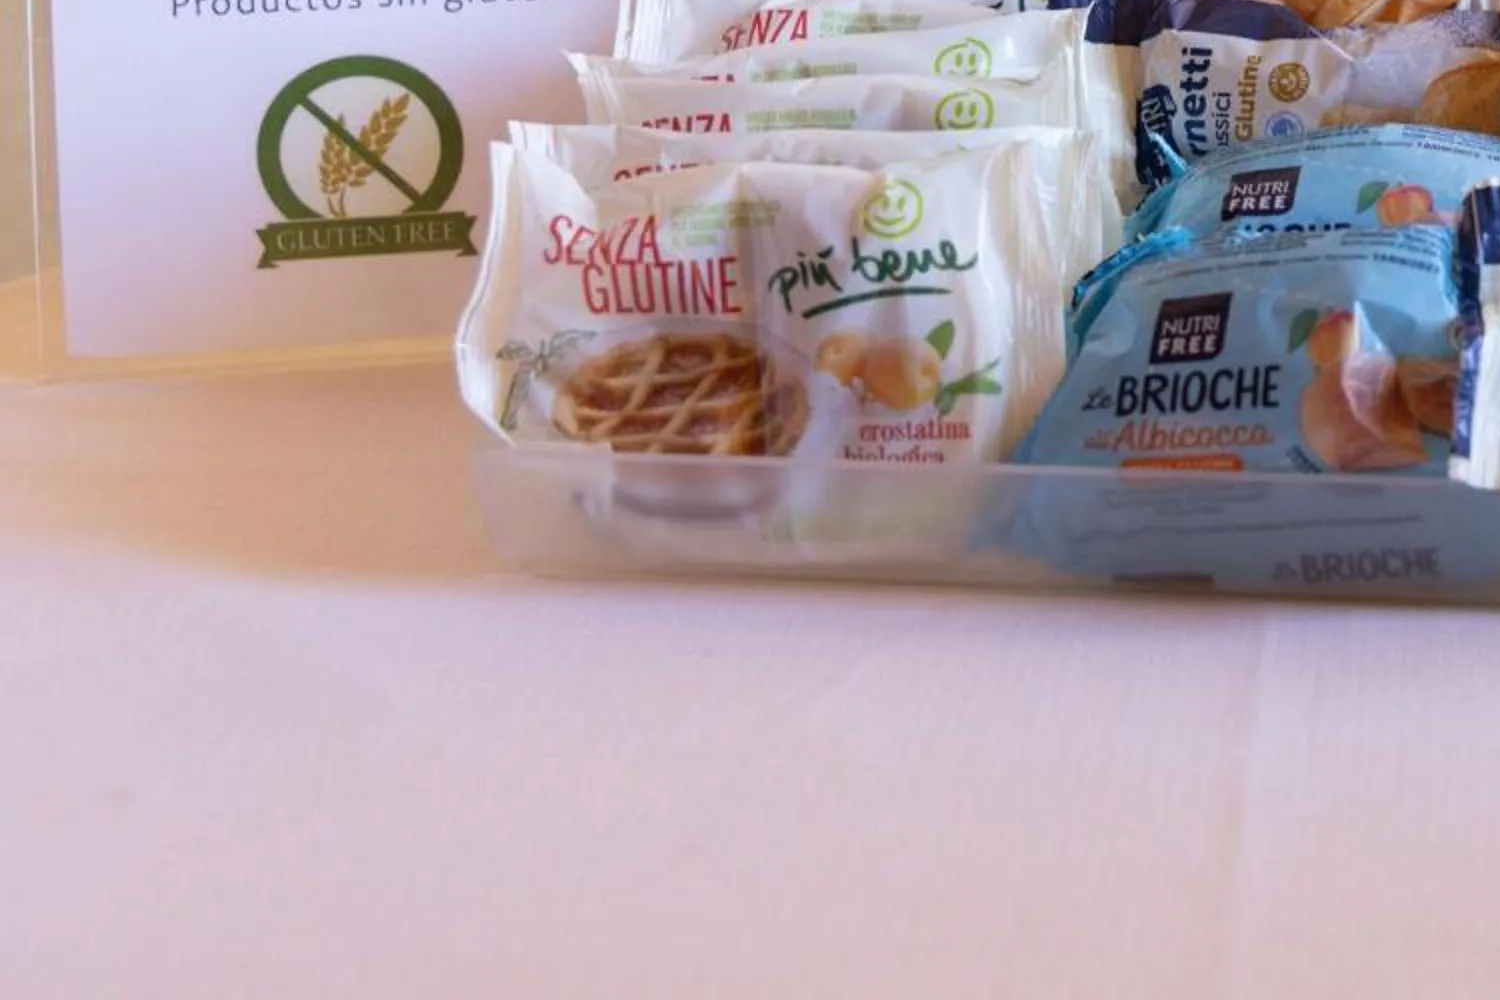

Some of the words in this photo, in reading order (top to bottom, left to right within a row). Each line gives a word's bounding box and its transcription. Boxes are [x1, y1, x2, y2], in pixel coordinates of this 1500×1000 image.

[1231, 180, 1289, 198] NUTRI
[1228, 195, 1289, 213] FREE
[276, 225, 386, 251] GLUTEN
[394, 221, 456, 245] FREE
[544, 215, 661, 267] SENZA
[851, 236, 980, 284] bene
[582, 256, 743, 315] GLUTINE
[1161, 314, 1221, 336] NUTRI
[1156, 335, 1218, 358] FREE
[1115, 364, 1282, 417] BRIOCHE
[858, 418, 973, 442] crostatina
